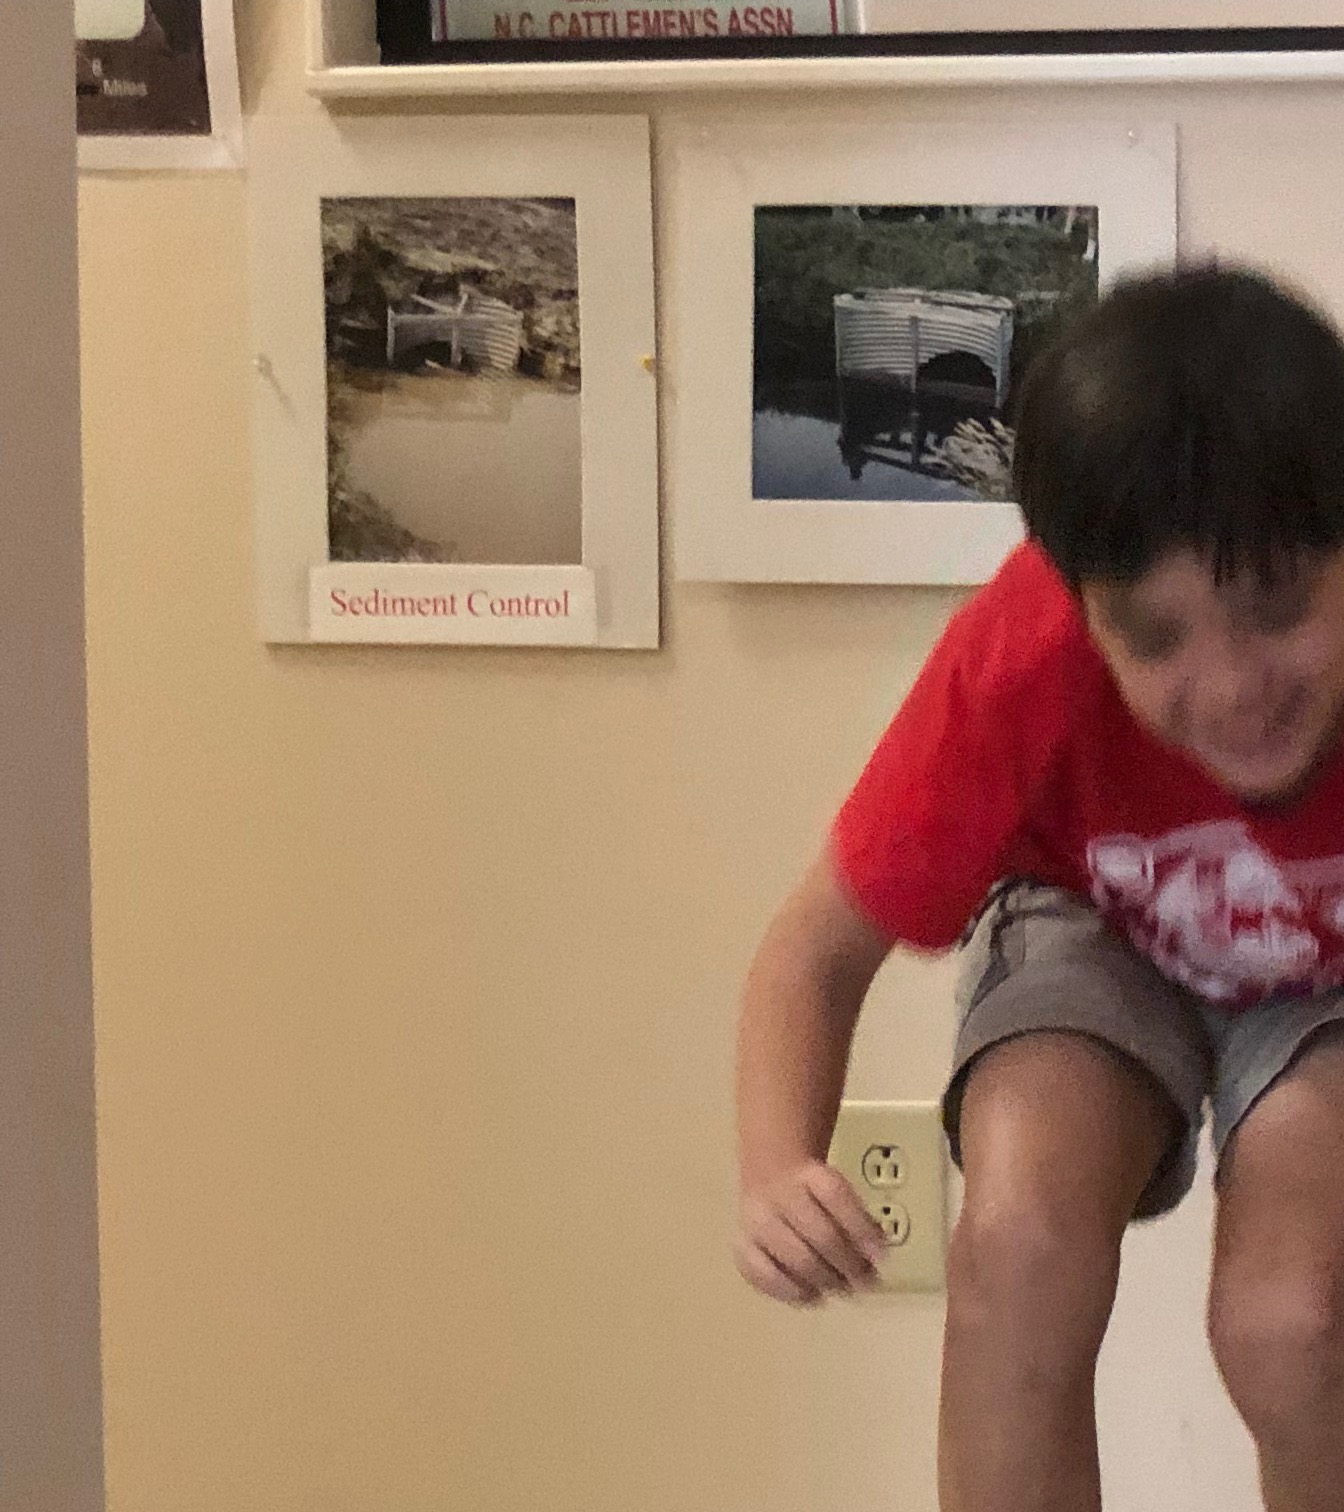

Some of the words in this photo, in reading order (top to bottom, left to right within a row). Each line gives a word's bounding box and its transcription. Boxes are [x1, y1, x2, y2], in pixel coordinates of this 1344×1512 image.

[548, 8, 719, 38] CATTLEMEN'S
[330, 588, 458, 617] Sediment
[466, 588, 570, 618] Control
